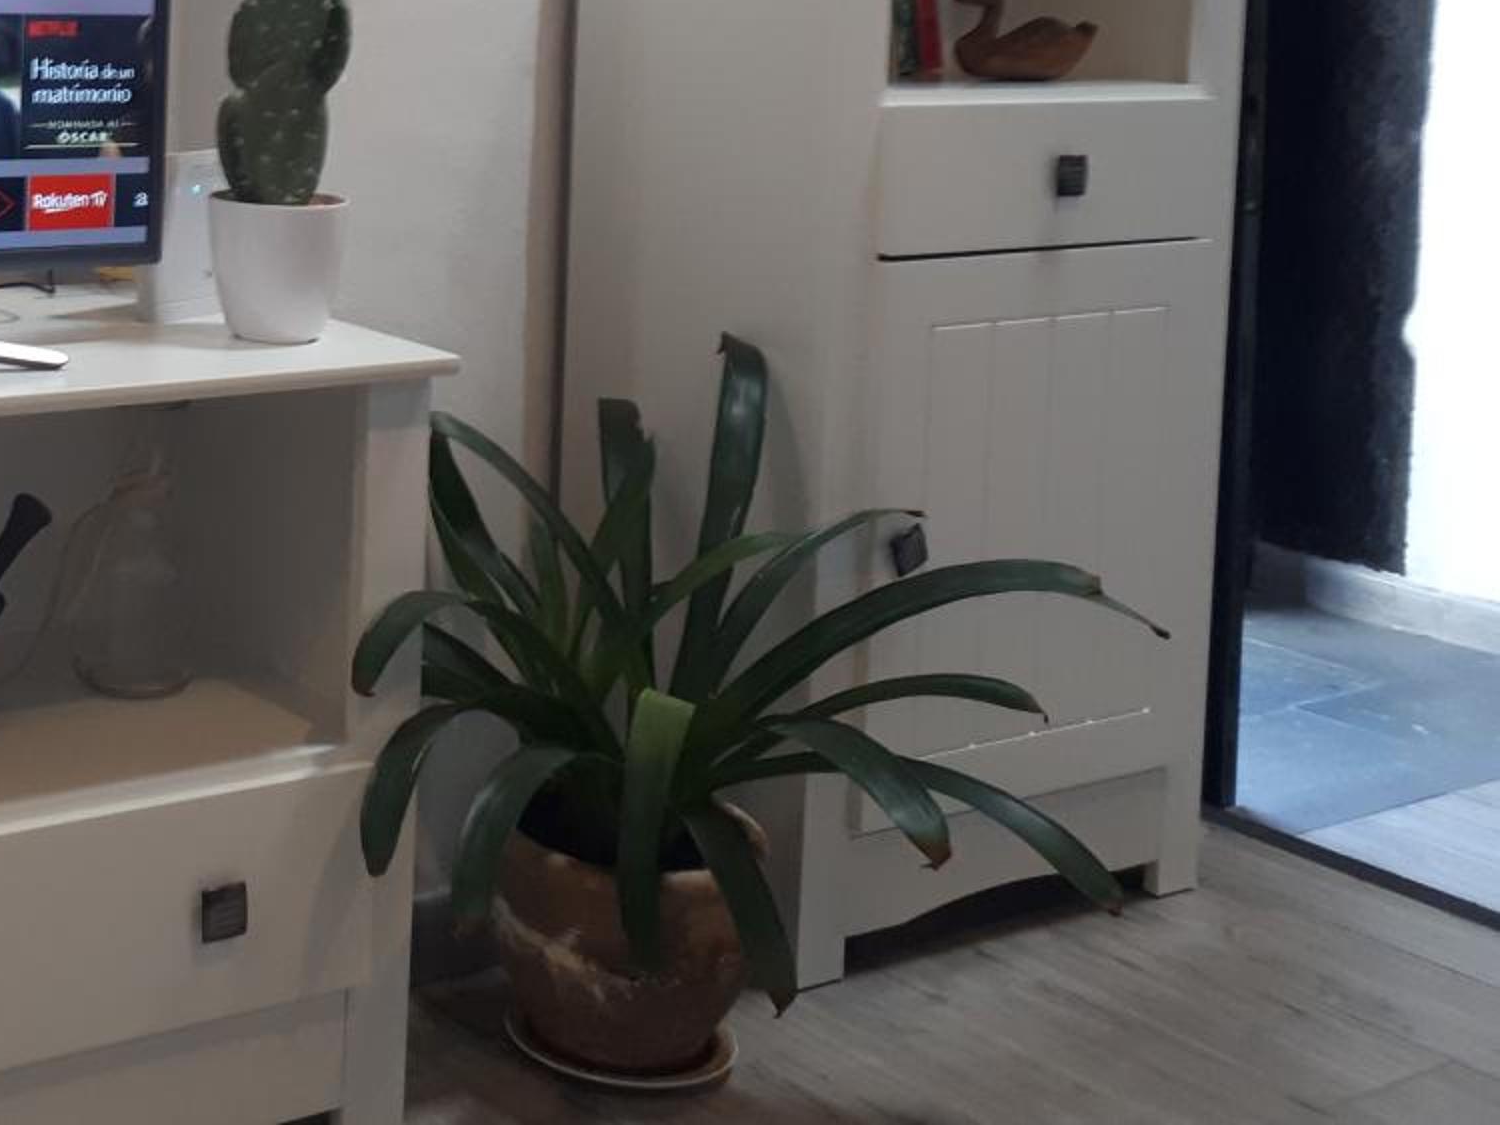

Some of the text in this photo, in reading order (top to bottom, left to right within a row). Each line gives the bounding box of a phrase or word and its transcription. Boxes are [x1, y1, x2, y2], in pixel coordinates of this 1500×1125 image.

[29, 57, 135, 80] Historia de un
[31, 83, 132, 104] matrimonio
[33, 192, 90, 211] Rakuten
